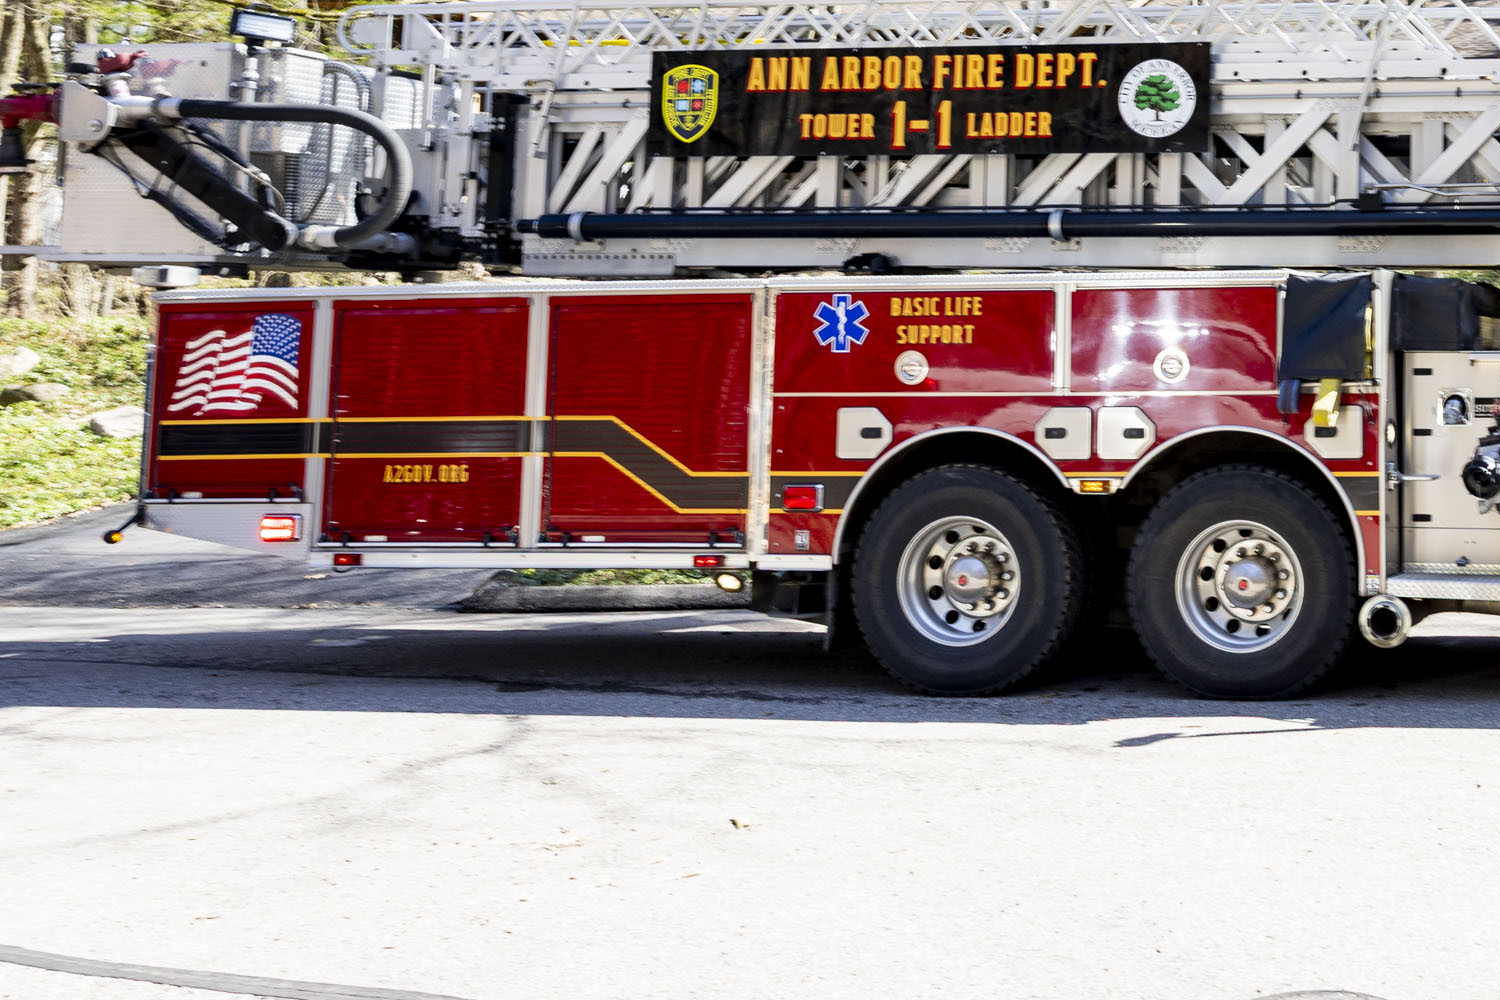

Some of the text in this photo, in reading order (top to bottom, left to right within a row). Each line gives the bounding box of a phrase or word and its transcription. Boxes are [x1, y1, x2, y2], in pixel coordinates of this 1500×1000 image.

[746, 52, 1107, 92] ANN ARBOR FIRE DEPT.
[799, 100, 1052, 149] TOWER 1-1 LADDER
[890, 296, 983, 317] BASIC LIFE
[896, 324, 975, 344] SUPPORT
[383, 464, 470, 483] A2GOV.ORG
